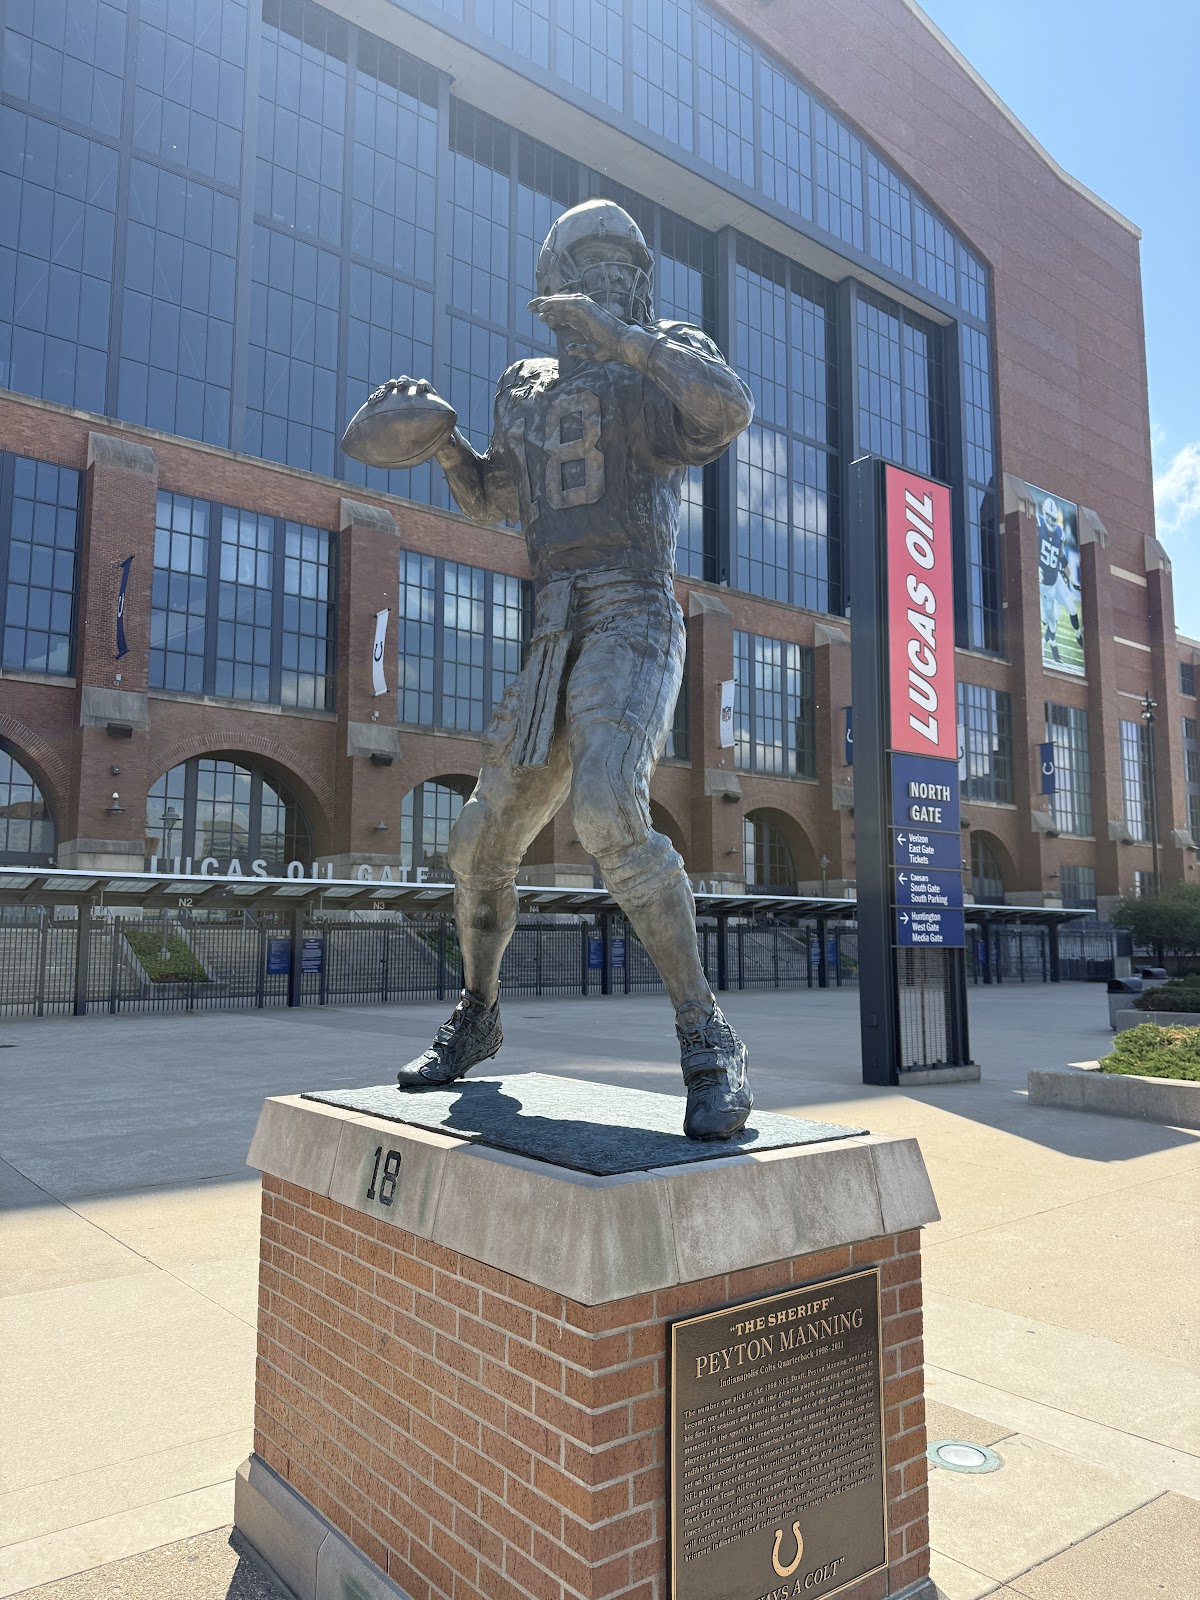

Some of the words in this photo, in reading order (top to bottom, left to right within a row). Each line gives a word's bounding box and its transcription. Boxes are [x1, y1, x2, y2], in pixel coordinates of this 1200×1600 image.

[1041, 539, 1059, 569] 56
[906, 573, 939, 746] LUCAS
[909, 781, 950, 802] NORTH
[911, 805, 942, 823] GATE
[908, 833, 929, 844] Verizon
[908, 844, 921, 854] East
[921, 845, 935, 855] Gate
[909, 854, 929, 865] Tickets
[910, 873, 929, 883] Caesars
[910, 883, 926, 893] South
[927, 884, 941, 894] Gate
[178, 898, 193, 907] N2
[911, 894, 927, 904] South
[927, 895, 948, 906] Parking
[373, 902, 386, 910] N3
[911, 912, 941, 923] Huntington
[912, 922, 926, 932] West
[926, 923, 940, 932] Gate
[912, 932, 930, 942] Media
[930, 933, 943, 943] Gate
[367, 1146, 402, 1207] 18
[694, 1335, 774, 1379] PEYTON
[779, 1308, 864, 1352] MANNING
[719, 1368, 759, 1388] Indianapolis
[760, 1363, 776, 1376] Colts
[777, 1351, 815, 1371] Quarterback
[793, 1581, 802, 1597] A
